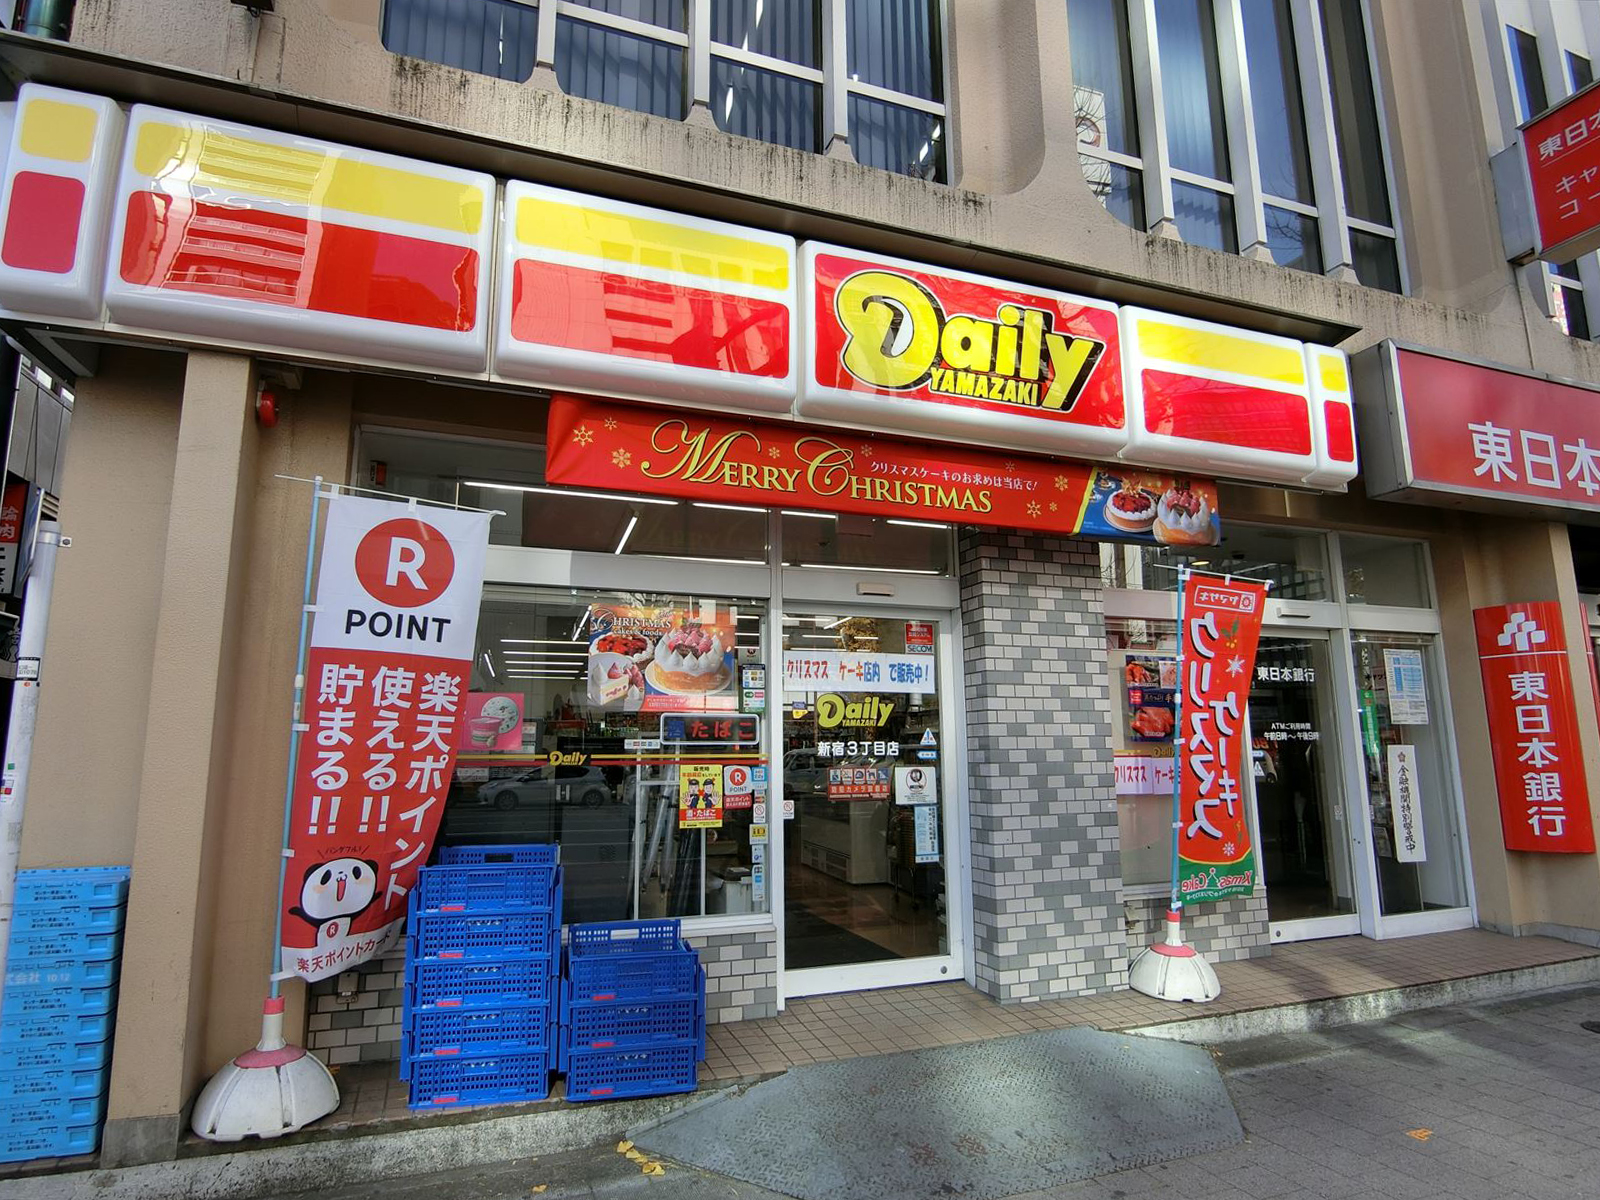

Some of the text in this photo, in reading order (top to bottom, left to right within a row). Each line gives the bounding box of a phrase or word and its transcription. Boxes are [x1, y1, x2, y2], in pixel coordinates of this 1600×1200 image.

[835, 270, 1102, 412] Daily
[930, 366, 1040, 406] YAMAZAKI
[794, 436, 993, 513] CHRISTMAS
[870, 460, 1038, 492] クリスマスケーキのお求めは当店で!
[1467, 421, 1600, 496] 東日本
[345, 608, 451, 643] POINT
[590, 608, 672, 631] CHRISTMAS
[613, 628, 634, 636] cakes
[907, 644, 932, 652] SECOM
[787, 660, 829, 679] クリスマス
[1257, 666, 1316, 682] 東日本銀行
[817, 693, 895, 728] Daily
[842, 719, 877, 727] YAMAZAKI
[692, 721, 753, 738] たばこ
[308, 663, 365, 835] 貯まる!!
[358, 665, 416, 833] 使える!!
[550, 750, 587, 766] Daily
[1508, 670, 1567, 836] 東日本銀行
[385, 671, 462, 911] 楽天ポイント
[297, 929, 392, 973] 楽天ポイントカード
